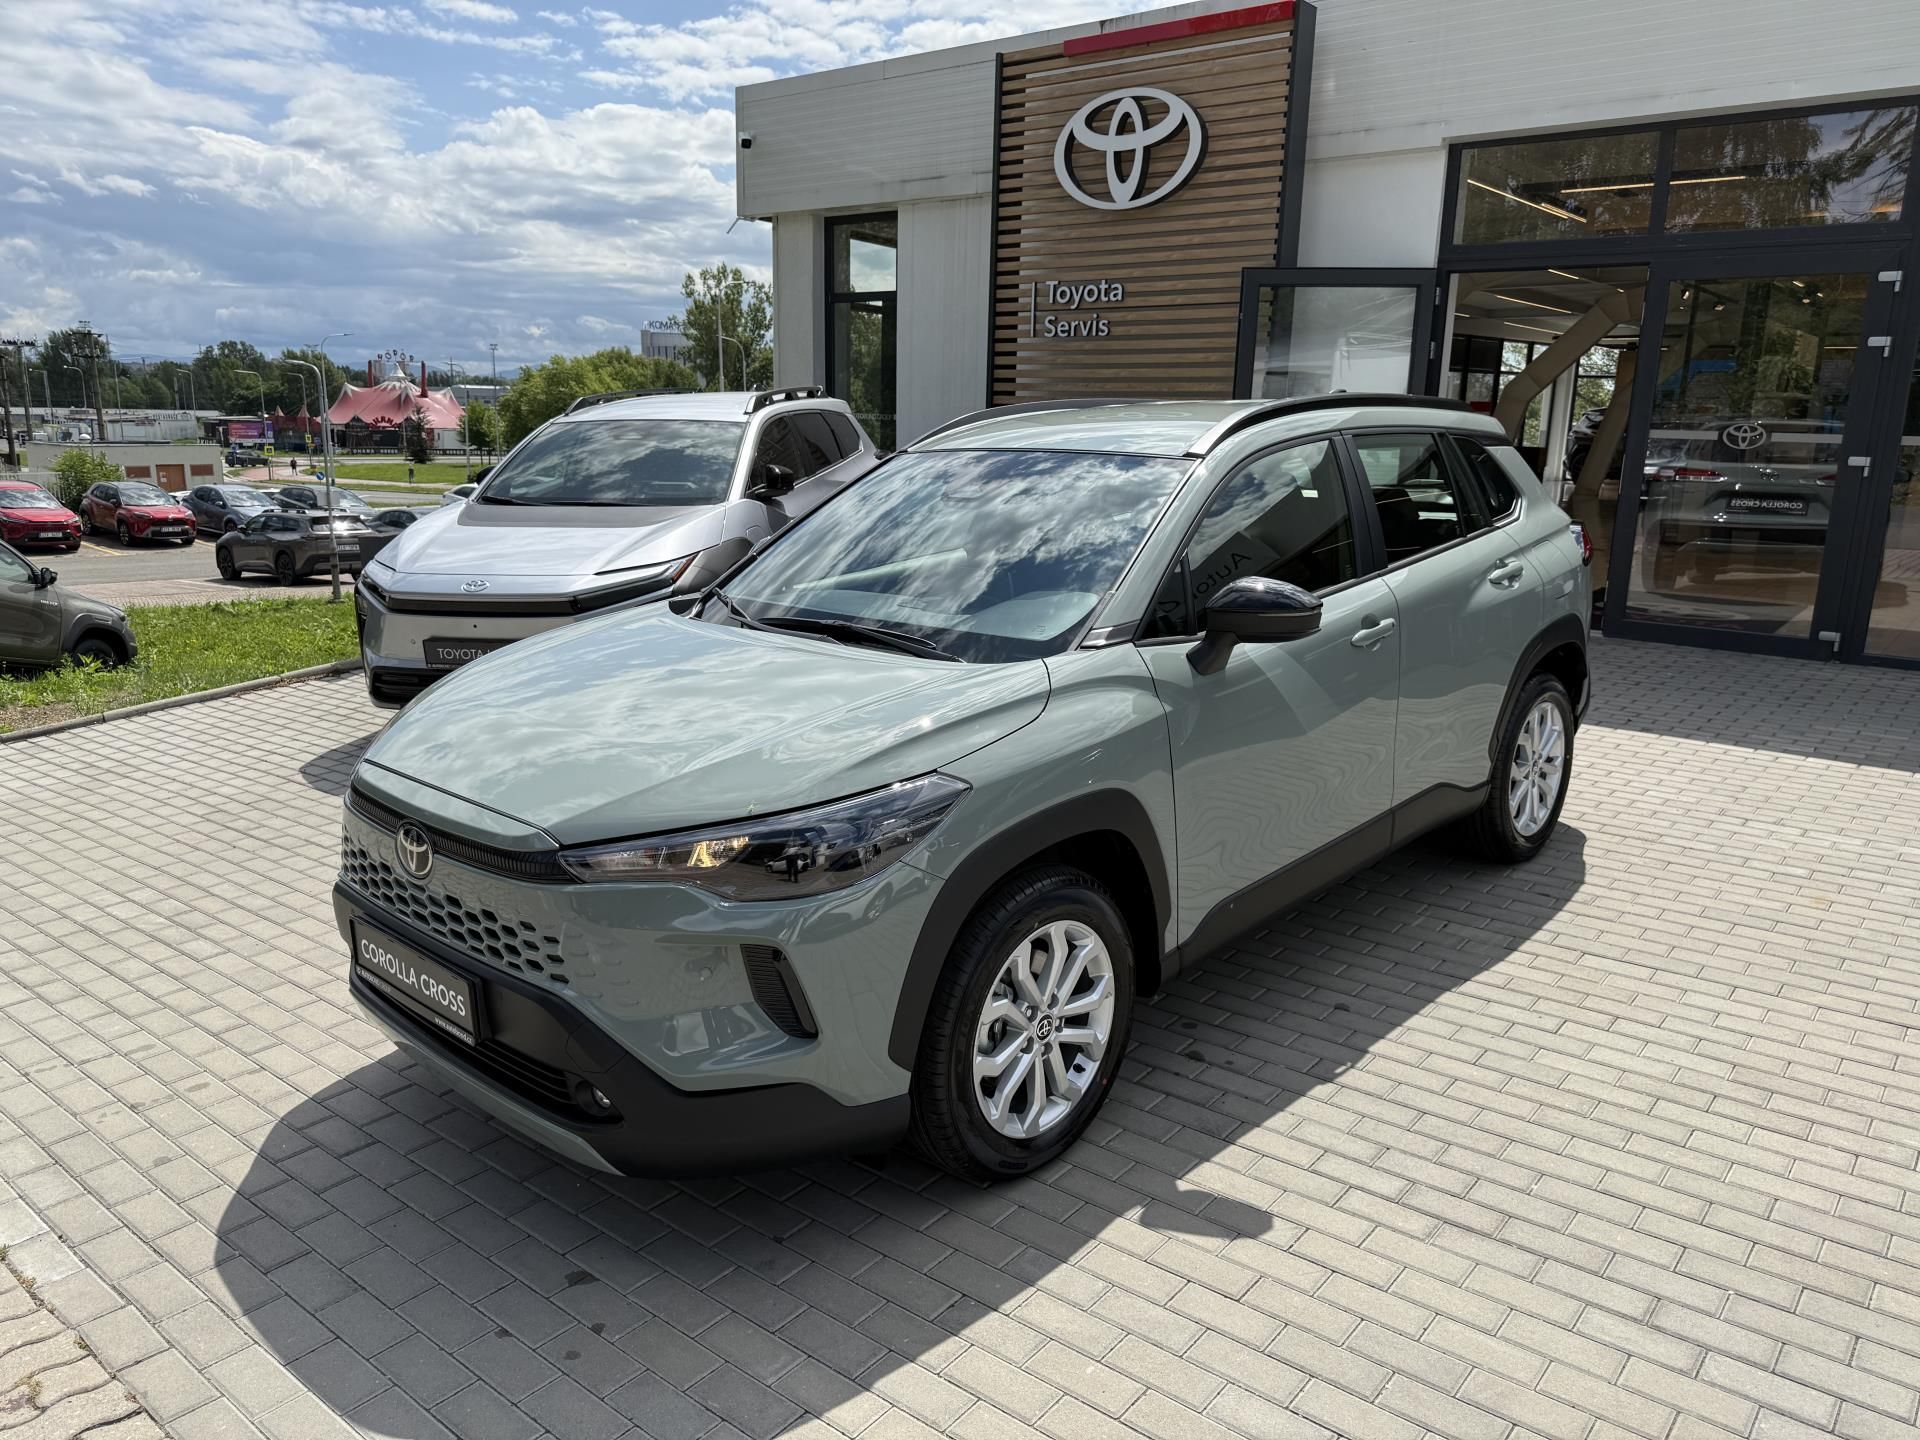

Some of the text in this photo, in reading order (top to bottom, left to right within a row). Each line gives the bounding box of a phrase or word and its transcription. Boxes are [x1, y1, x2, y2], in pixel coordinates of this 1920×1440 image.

[1045, 280, 1123, 310] Toyota
[1043, 313, 1110, 338] Servis
[436, 648, 484, 660] TOYOTA
[361, 938, 466, 1016] COROLLA CROSS
